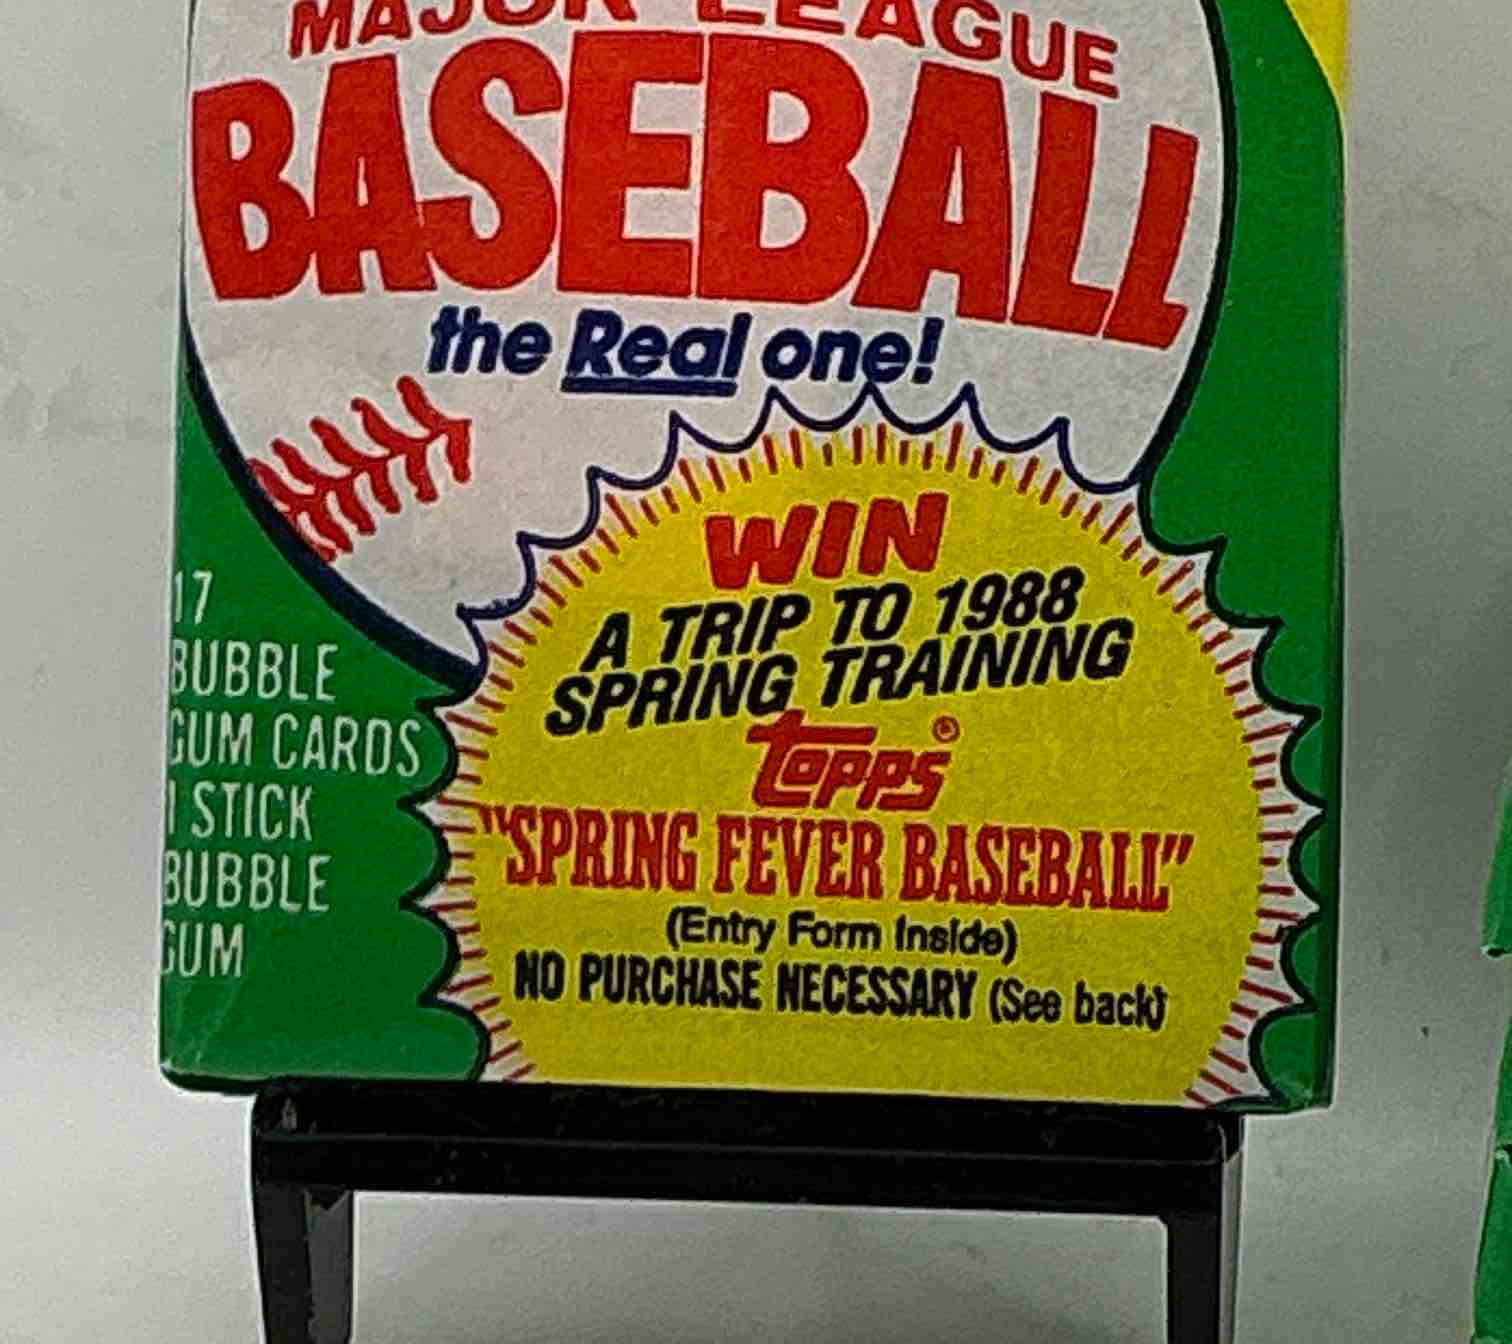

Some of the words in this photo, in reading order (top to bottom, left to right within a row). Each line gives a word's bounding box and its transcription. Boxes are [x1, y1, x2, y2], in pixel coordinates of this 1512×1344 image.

[192, 29, 1200, 351] BASEBALL
[428, 306, 552, 378] the
[561, 310, 743, 394] Real
[762, 317, 940, 384] one!
[705, 492, 950, 590] WIN
[174, 570, 214, 625] 17
[579, 612, 630, 672] A
[659, 594, 811, 664] TRIP
[831, 582, 912, 646] TO
[935, 565, 1085, 636] 1988
[171, 639, 339, 703] BUBBLE
[544, 653, 798, 737] SPRING
[820, 617, 1135, 709] TRAINING
[272, 712, 422, 778] CARDS
[191, 782, 314, 841] STICK
[163, 851, 333, 913] BUBBLE
[711, 812, 884, 899] FEVER
[666, 905, 776, 954] (Entry
[788, 911, 883, 952] Form
[895, 913, 1018, 966] Inside)
[513, 950, 566, 1001] NO
[578, 953, 763, 1009] PURCHASE
[776, 958, 978, 1019] NECESSARY
[989, 977, 1063, 1024] (See
[1074, 979, 1168, 1031] back)
